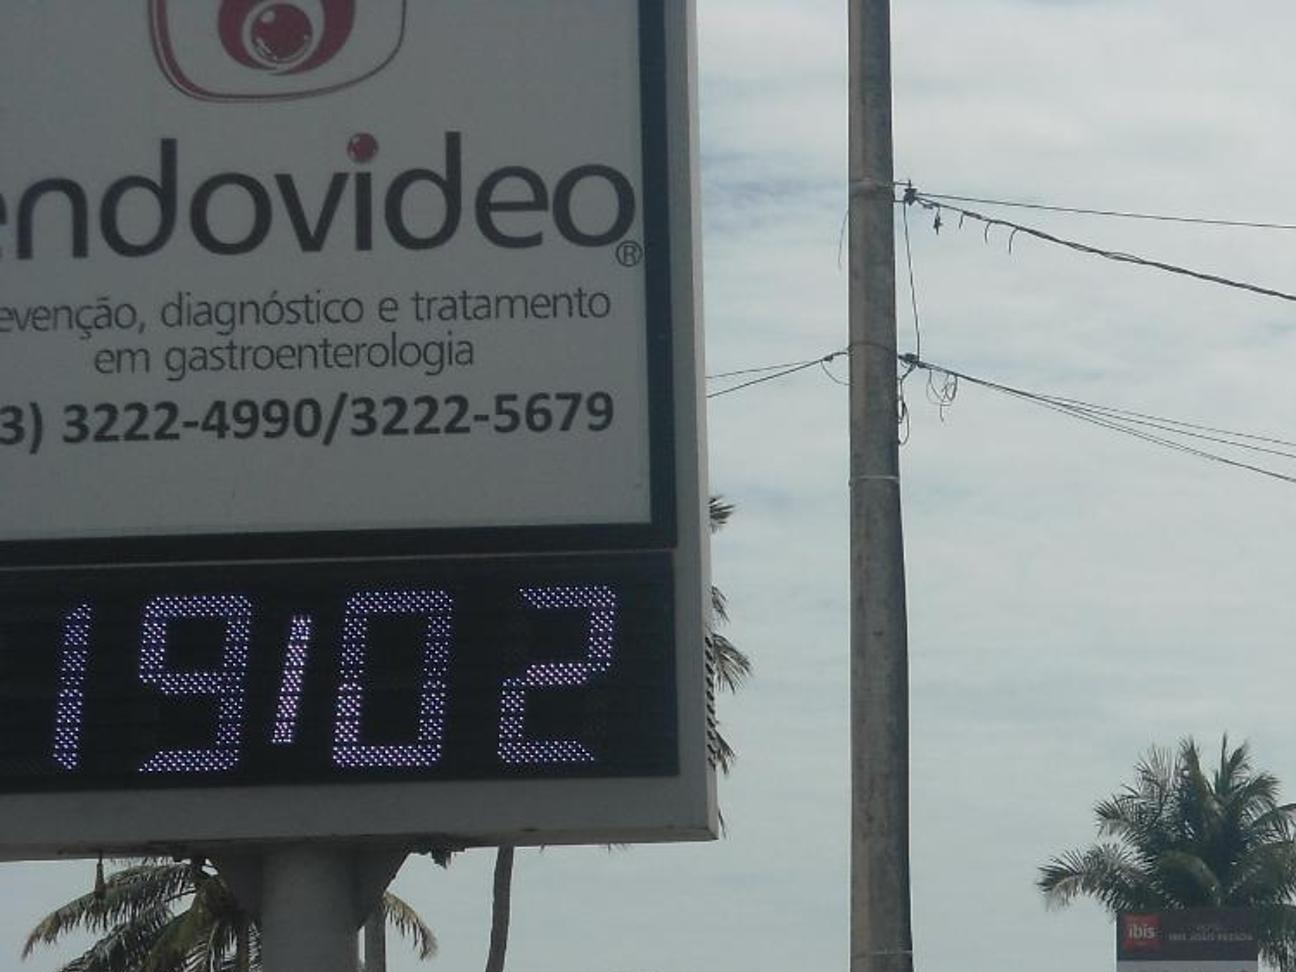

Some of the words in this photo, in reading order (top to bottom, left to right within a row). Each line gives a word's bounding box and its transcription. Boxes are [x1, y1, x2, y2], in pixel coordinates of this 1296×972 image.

[0, 131, 636, 260] ndovideo
[161, 290, 364, 335] diagnóstico
[378, 297, 399, 322] e
[411, 287, 611, 322] tratamento
[94, 347, 150, 374] em
[164, 331, 475, 382] gastroenterologia
[62, 391, 614, 446] 3222-4990/3222-5679
[1129, 923, 1155, 939] ibis
